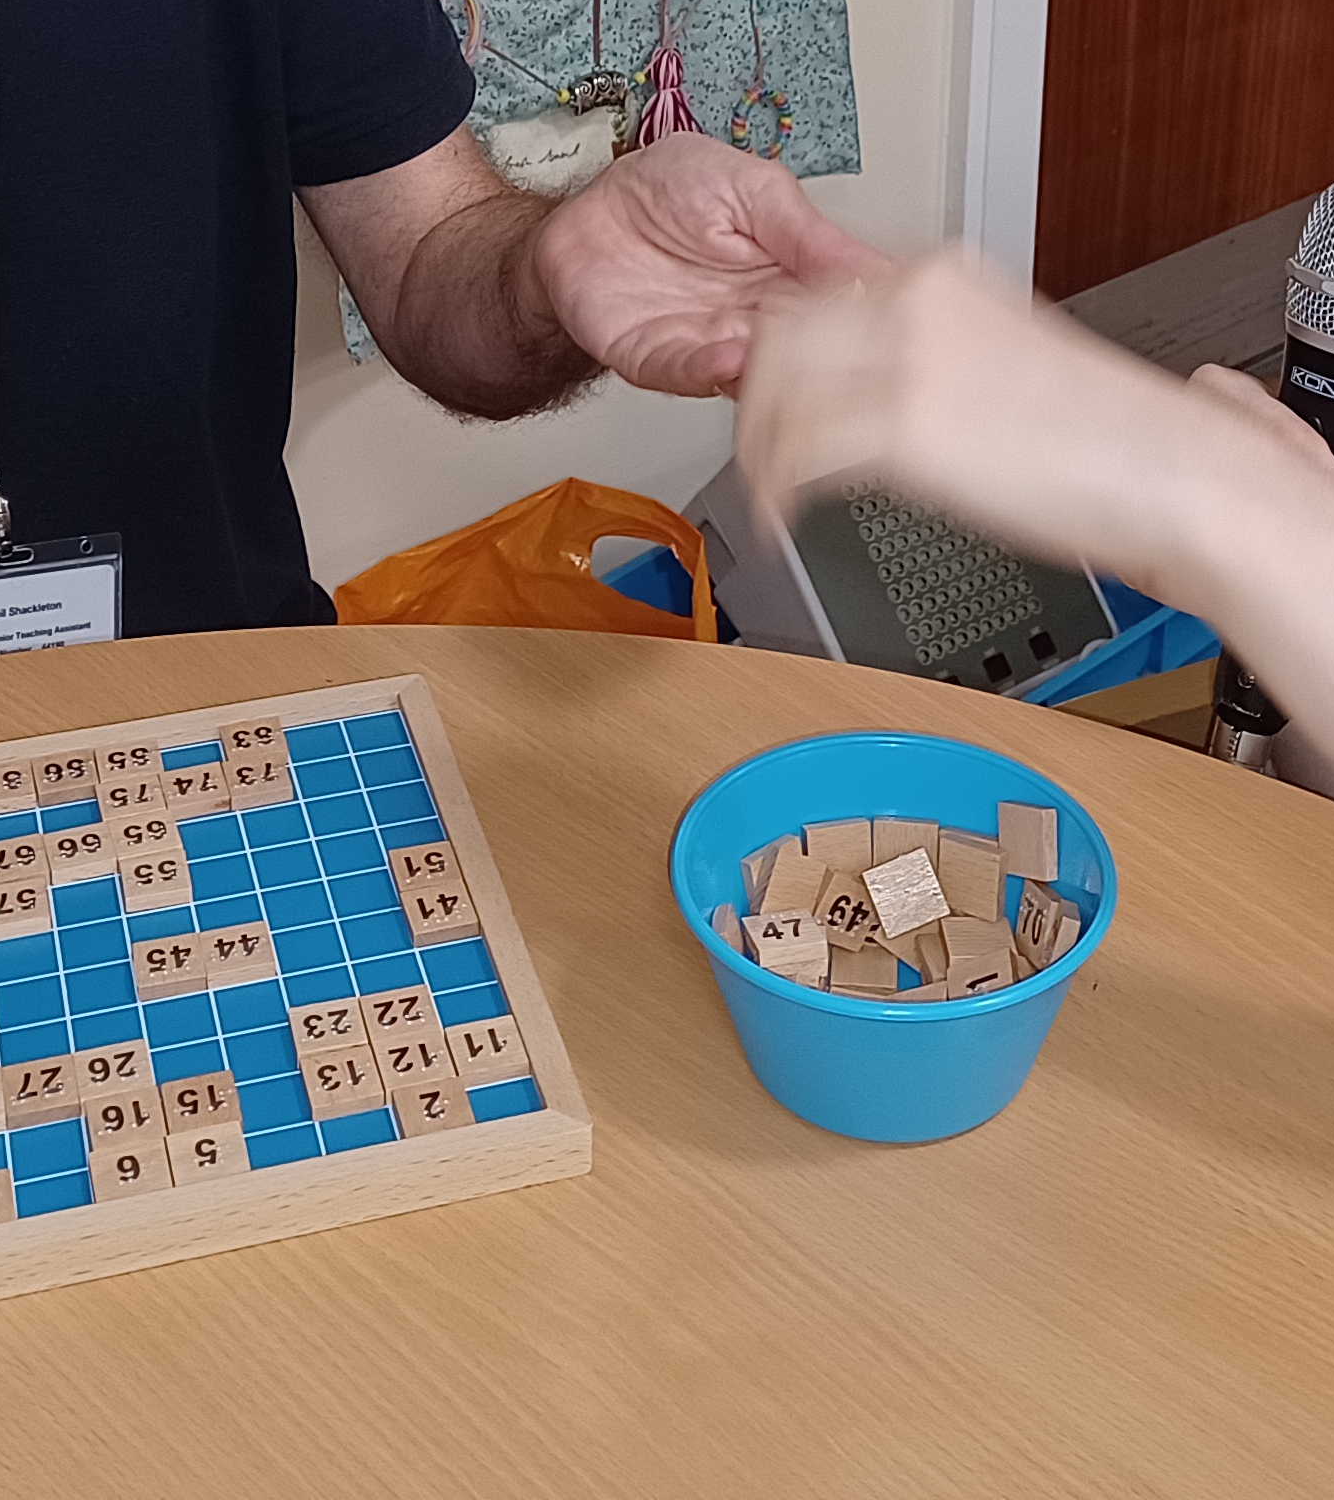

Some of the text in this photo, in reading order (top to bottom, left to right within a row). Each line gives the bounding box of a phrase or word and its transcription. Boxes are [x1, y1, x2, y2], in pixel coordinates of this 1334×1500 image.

[8, 602, 62, 617] Shackleton
[16, 628, 53, 640] Teaching
[232, 727, 274, 749] 83
[44, 759, 86, 783] 86
[107, 747, 150, 770] 85
[173, 772, 218, 795] 74
[236, 763, 279, 786] 73
[109, 784, 153, 808] 75
[57, 833, 101, 859] 66
[123, 820, 167, 845] 65
[134, 860, 178, 885] 55
[404, 852, 445, 879] 51
[416, 893, 459, 920] 41
[762, 918, 802, 940] 47
[146, 945, 192, 974] 45
[214, 933, 260, 961] 44
[302, 1009, 353, 1040] 23
[373, 995, 423, 1027] 22
[463, 1028, 508, 1059] 11
[87, 1051, 138, 1083] 26
[388, 1043, 438, 1074] 12
[16, 1066, 64, 1101] 27
[317, 1060, 366, 1092] 13
[177, 1084, 226, 1117] 15
[419, 1091, 446, 1119] 2
[101, 1100, 151, 1132] 16
[194, 1138, 218, 1167] 5
[116, 1155, 141, 1182] 6
